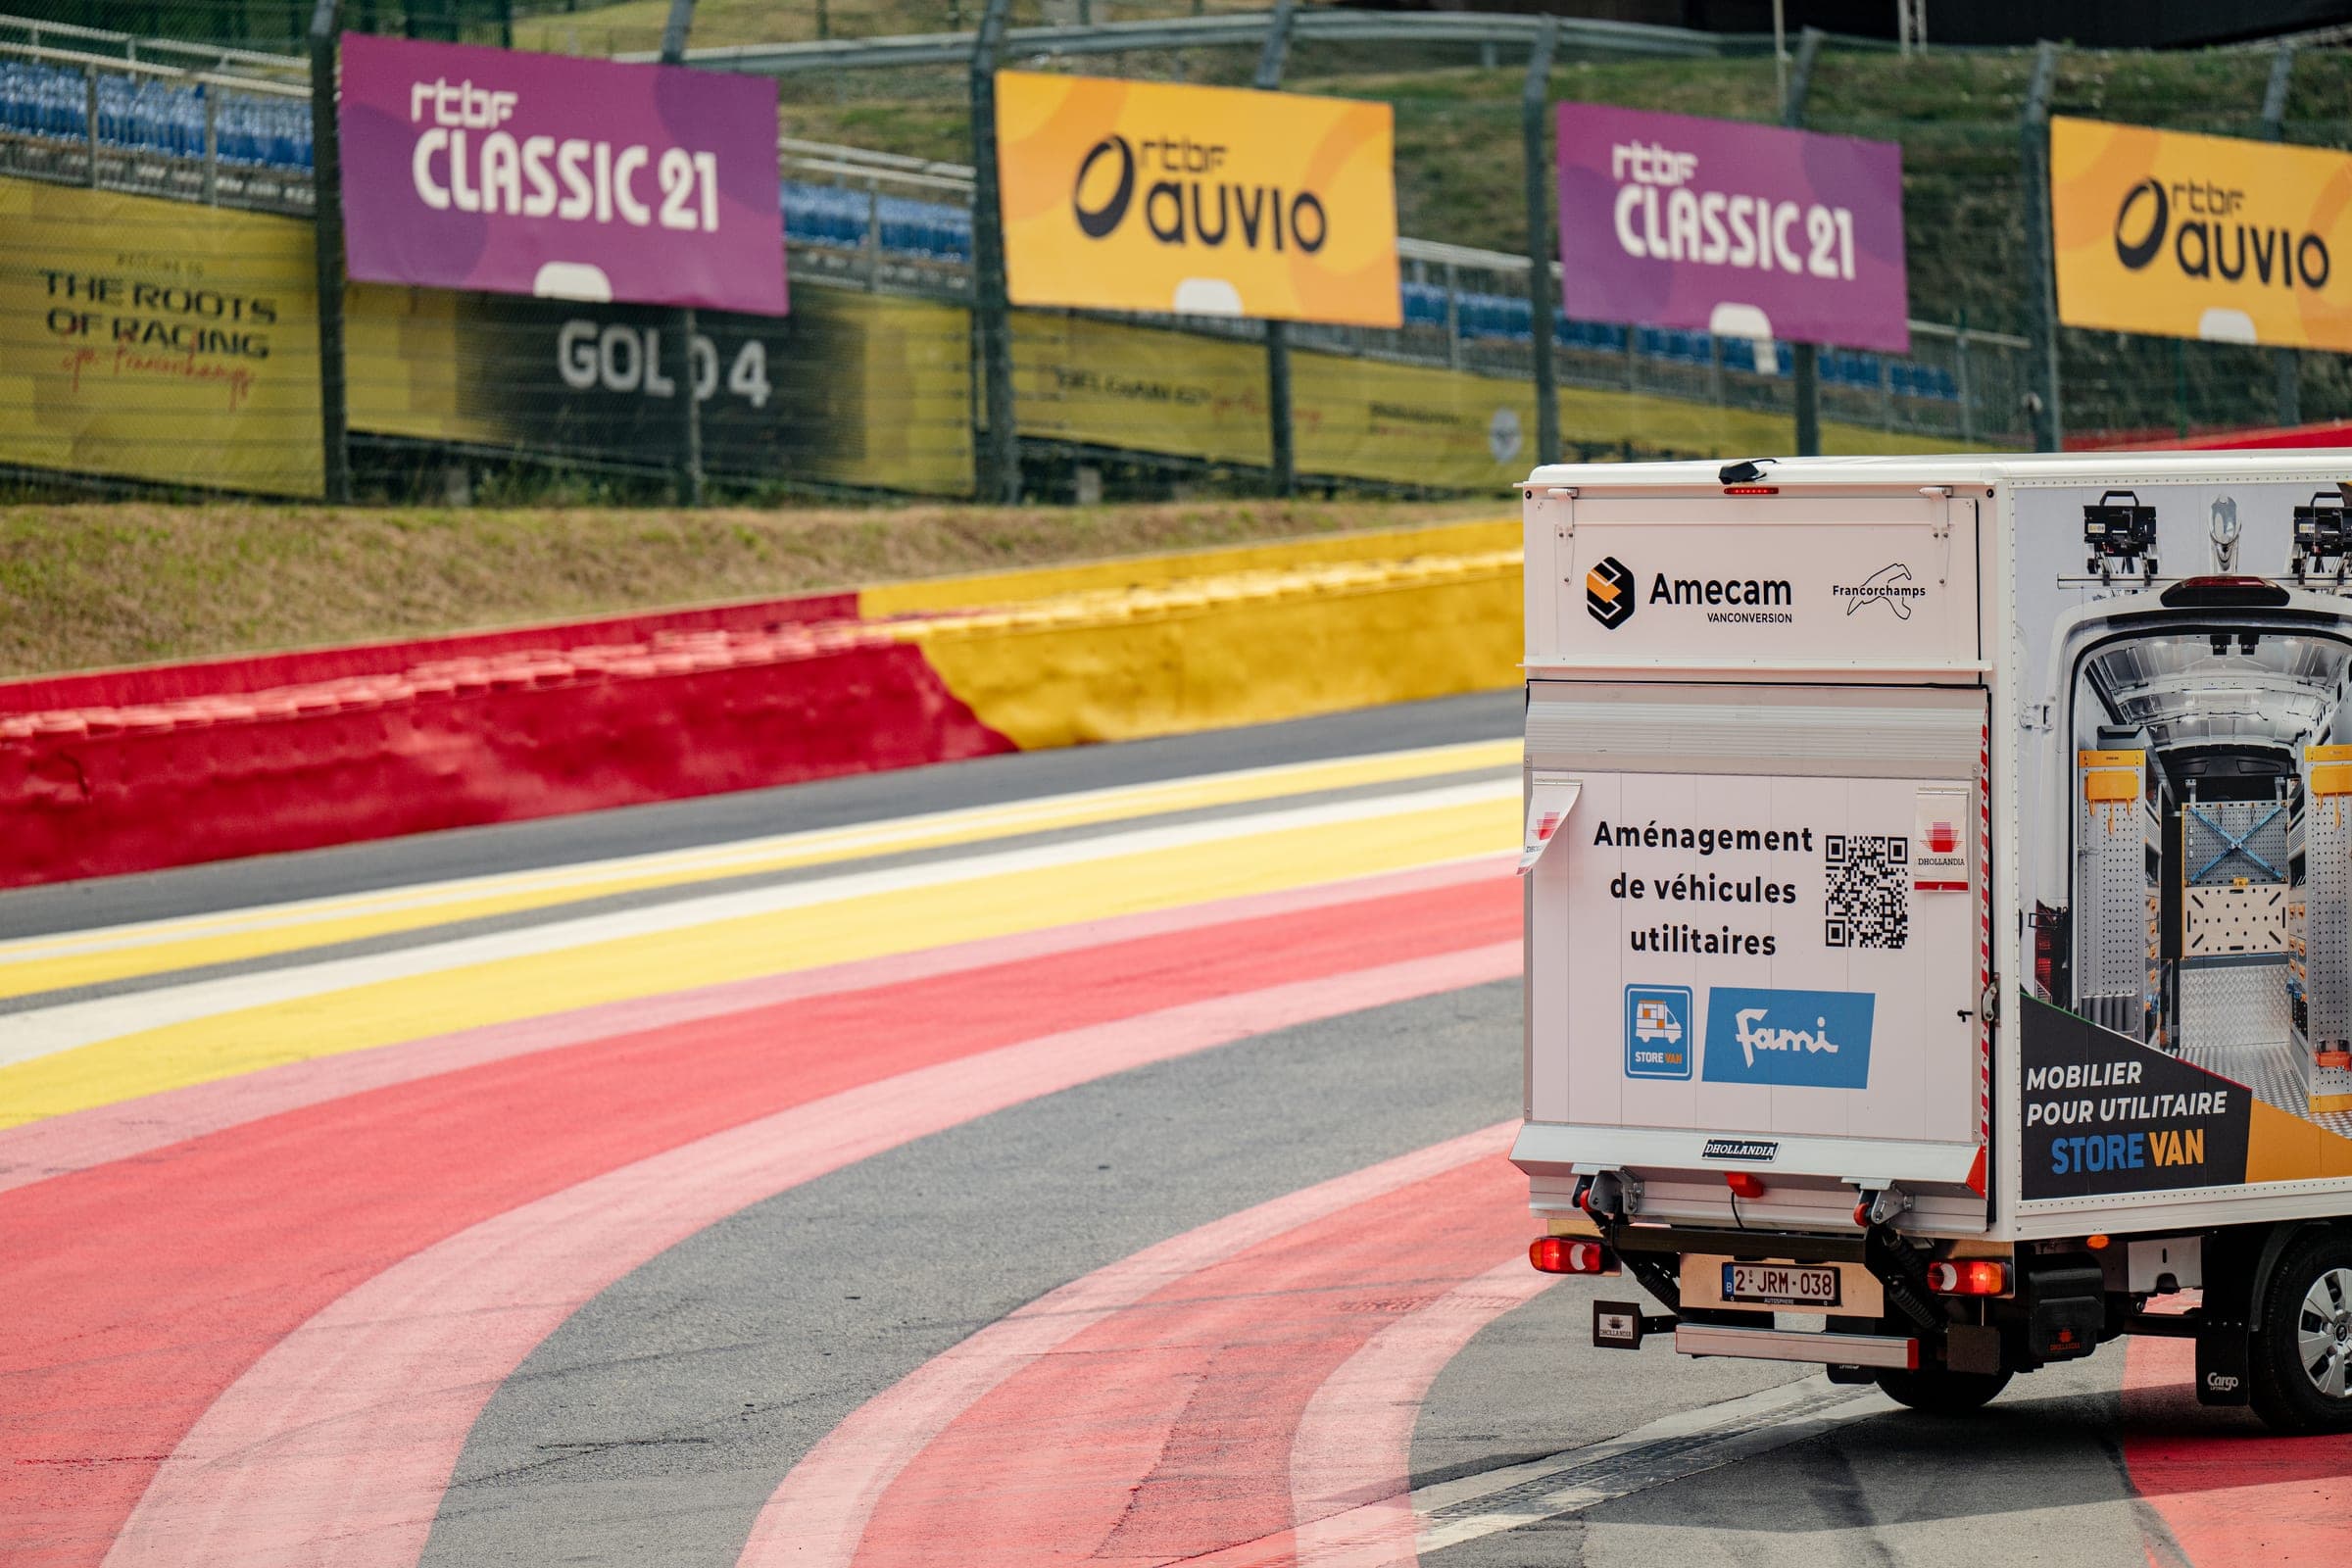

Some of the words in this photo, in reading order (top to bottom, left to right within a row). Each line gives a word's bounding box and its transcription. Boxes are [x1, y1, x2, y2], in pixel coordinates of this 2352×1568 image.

[412, 127, 651, 226] CLASSIC
[658, 147, 719, 232] 21
[1145, 180, 1327, 254] auvio
[1614, 183, 1803, 275] CLASSIC
[1806, 204, 1856, 281] 21
[2176, 219, 2330, 290] auvio
[41, 268, 123, 307] THE
[133, 281, 278, 324] ROOTS
[47, 307, 103, 336] OF
[112, 317, 270, 360] RACING
[728, 340, 772, 409] 4
[1649, 572, 1792, 606] Amecam
[1833, 585, 1926, 599] Francorchamps
[1707, 612, 1792, 623] VANCONVERSION
[1593, 820, 1813, 856] Aménagement
[1918, 858, 1965, 866] DHOLLANDIA
[1610, 872, 1645, 900] de
[1653, 874, 1796, 904] véhicules
[1630, 923, 1776, 956] utilitaires
[1635, 1052, 1664, 1064] STORE
[1665, 1053, 1683, 1064] VAN
[2026, 1061, 2142, 1091] MOBILIER
[2026, 1100, 2093, 1127] POUR
[2099, 1091, 2228, 1123] UTILITAIRE
[1705, 1144, 1775, 1156] DHOLLANDIA
[2051, 1133, 2144, 1175] STORE
[2148, 1128, 2205, 1167] VAN
[2207, 1372, 2239, 1392] Cargo
